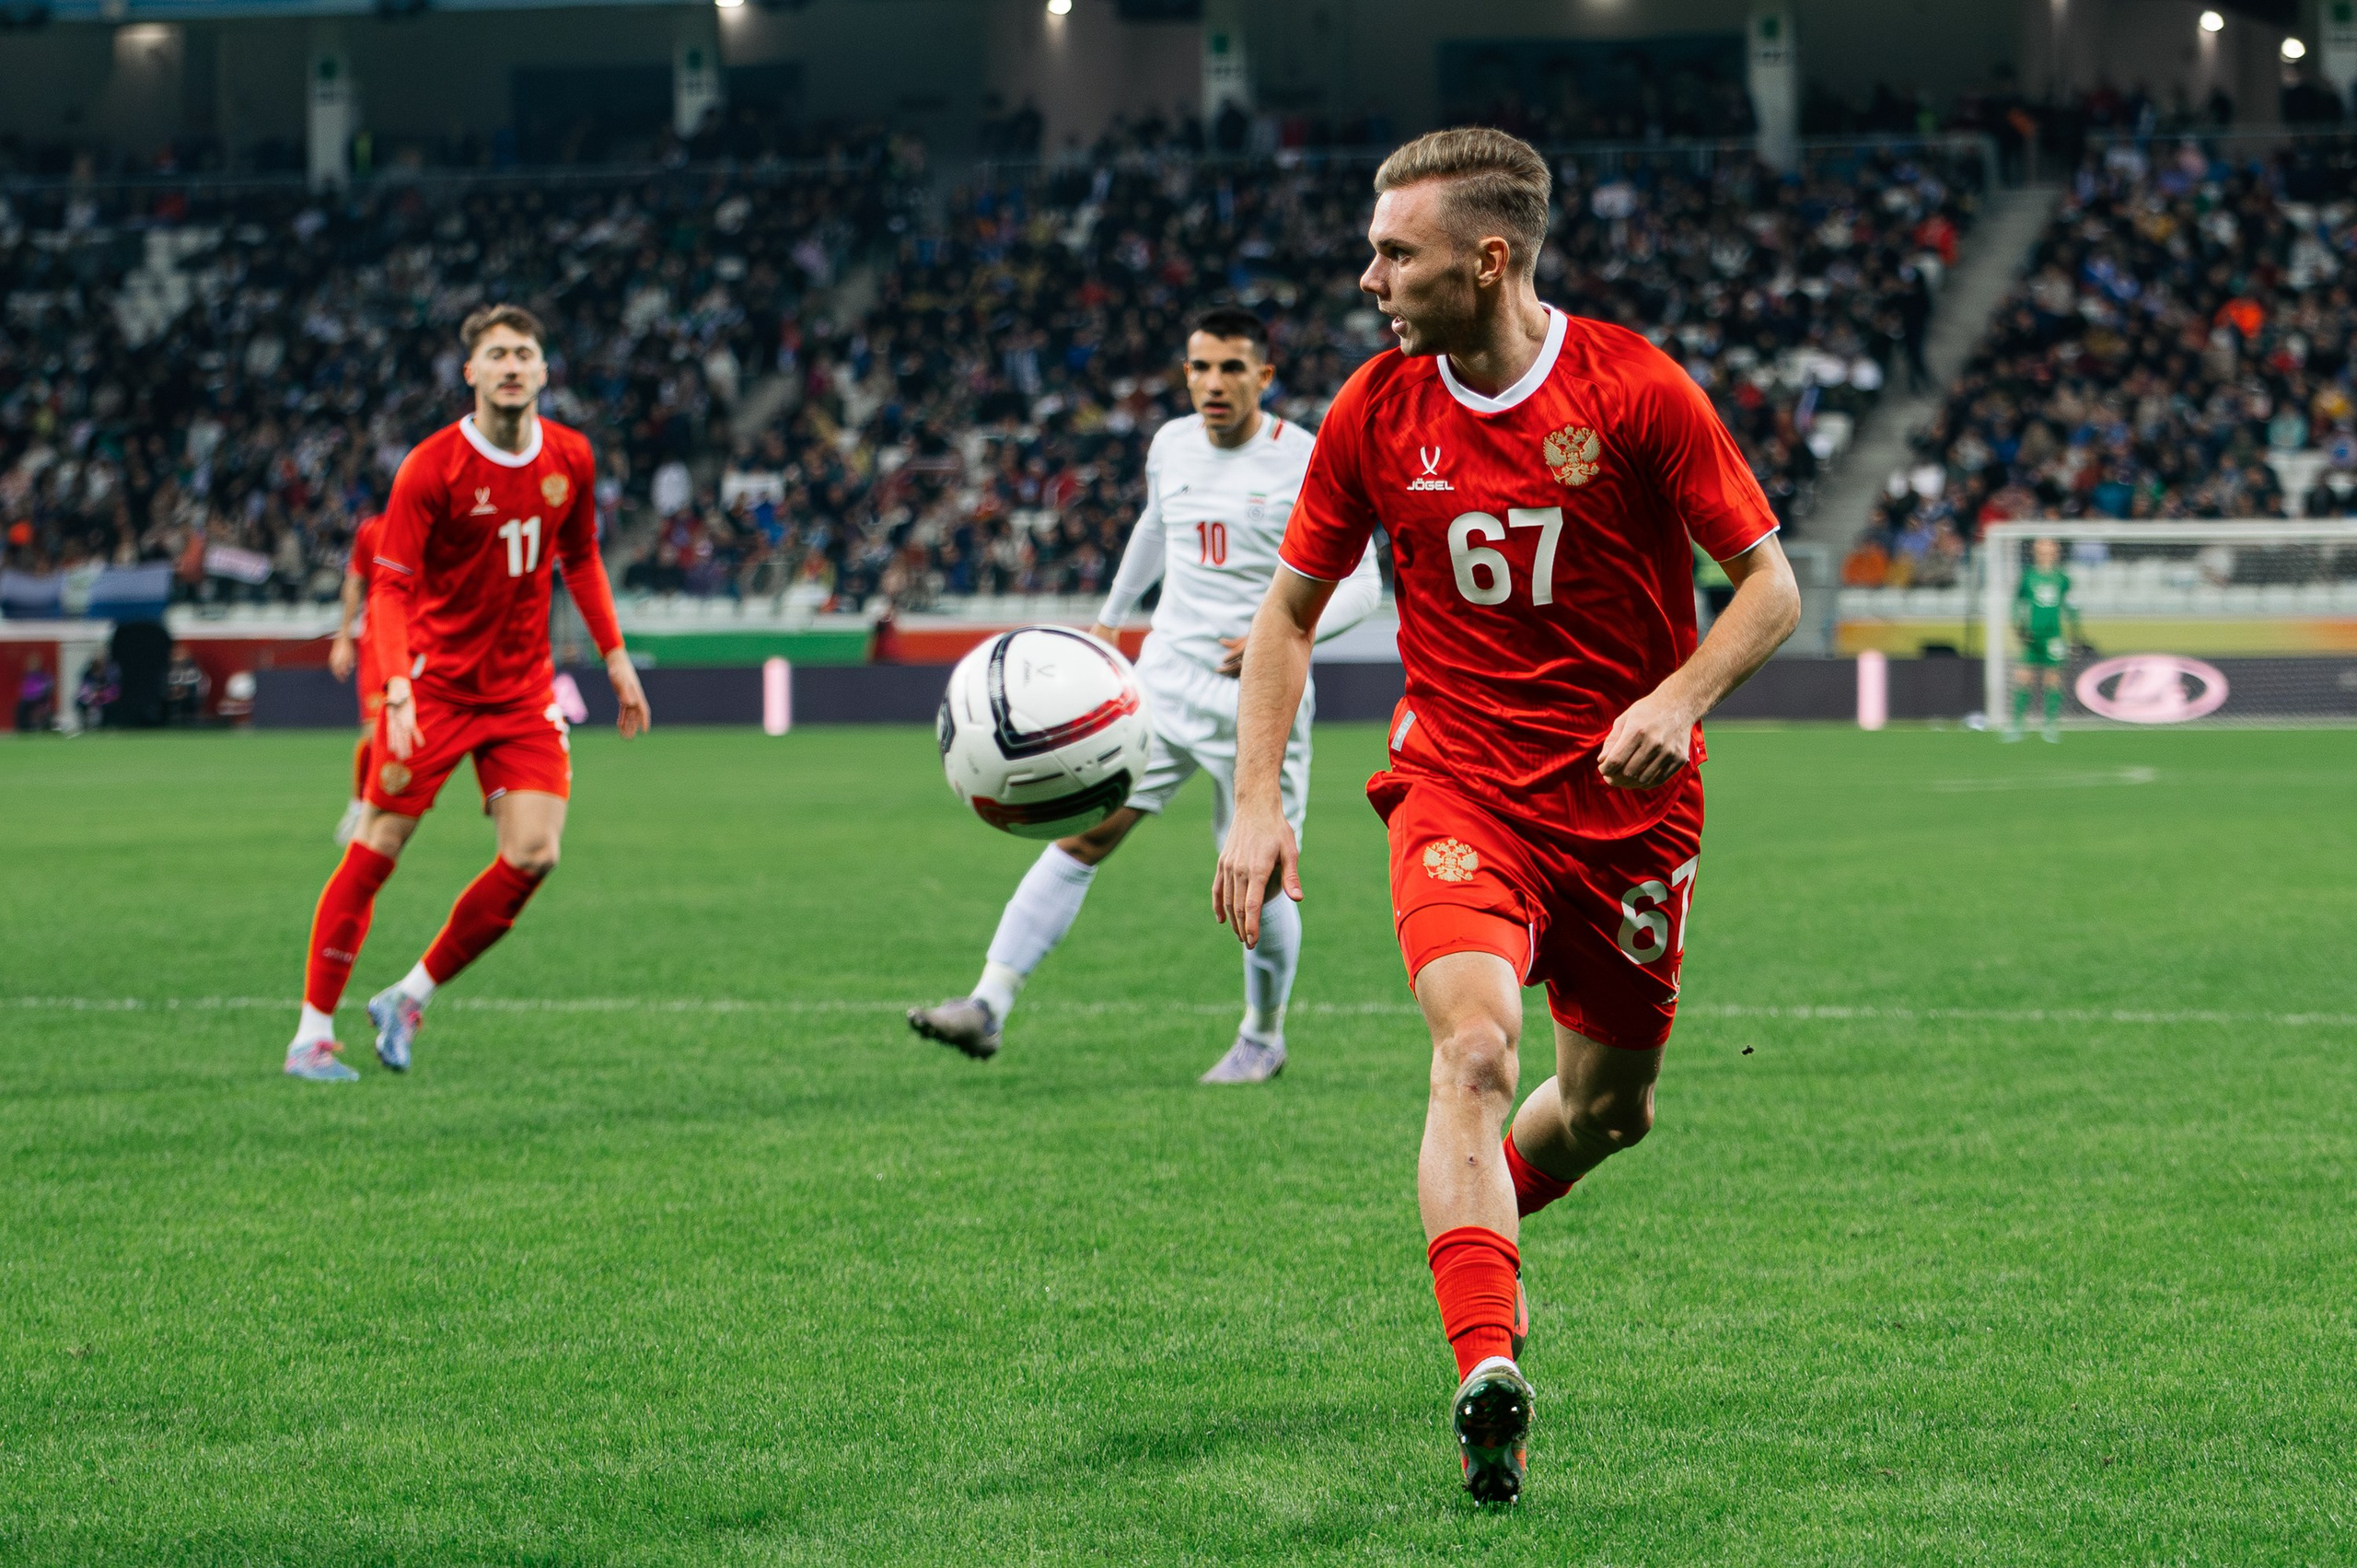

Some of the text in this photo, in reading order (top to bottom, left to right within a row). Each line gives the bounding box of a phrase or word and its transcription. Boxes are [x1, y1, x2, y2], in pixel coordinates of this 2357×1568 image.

[1407, 478, 1455, 491] JÖGEL
[497, 516, 542, 577] 11
[1195, 520, 1226, 565] 10
[1447, 506, 1563, 606] 67
[1618, 854, 1700, 964] 67
